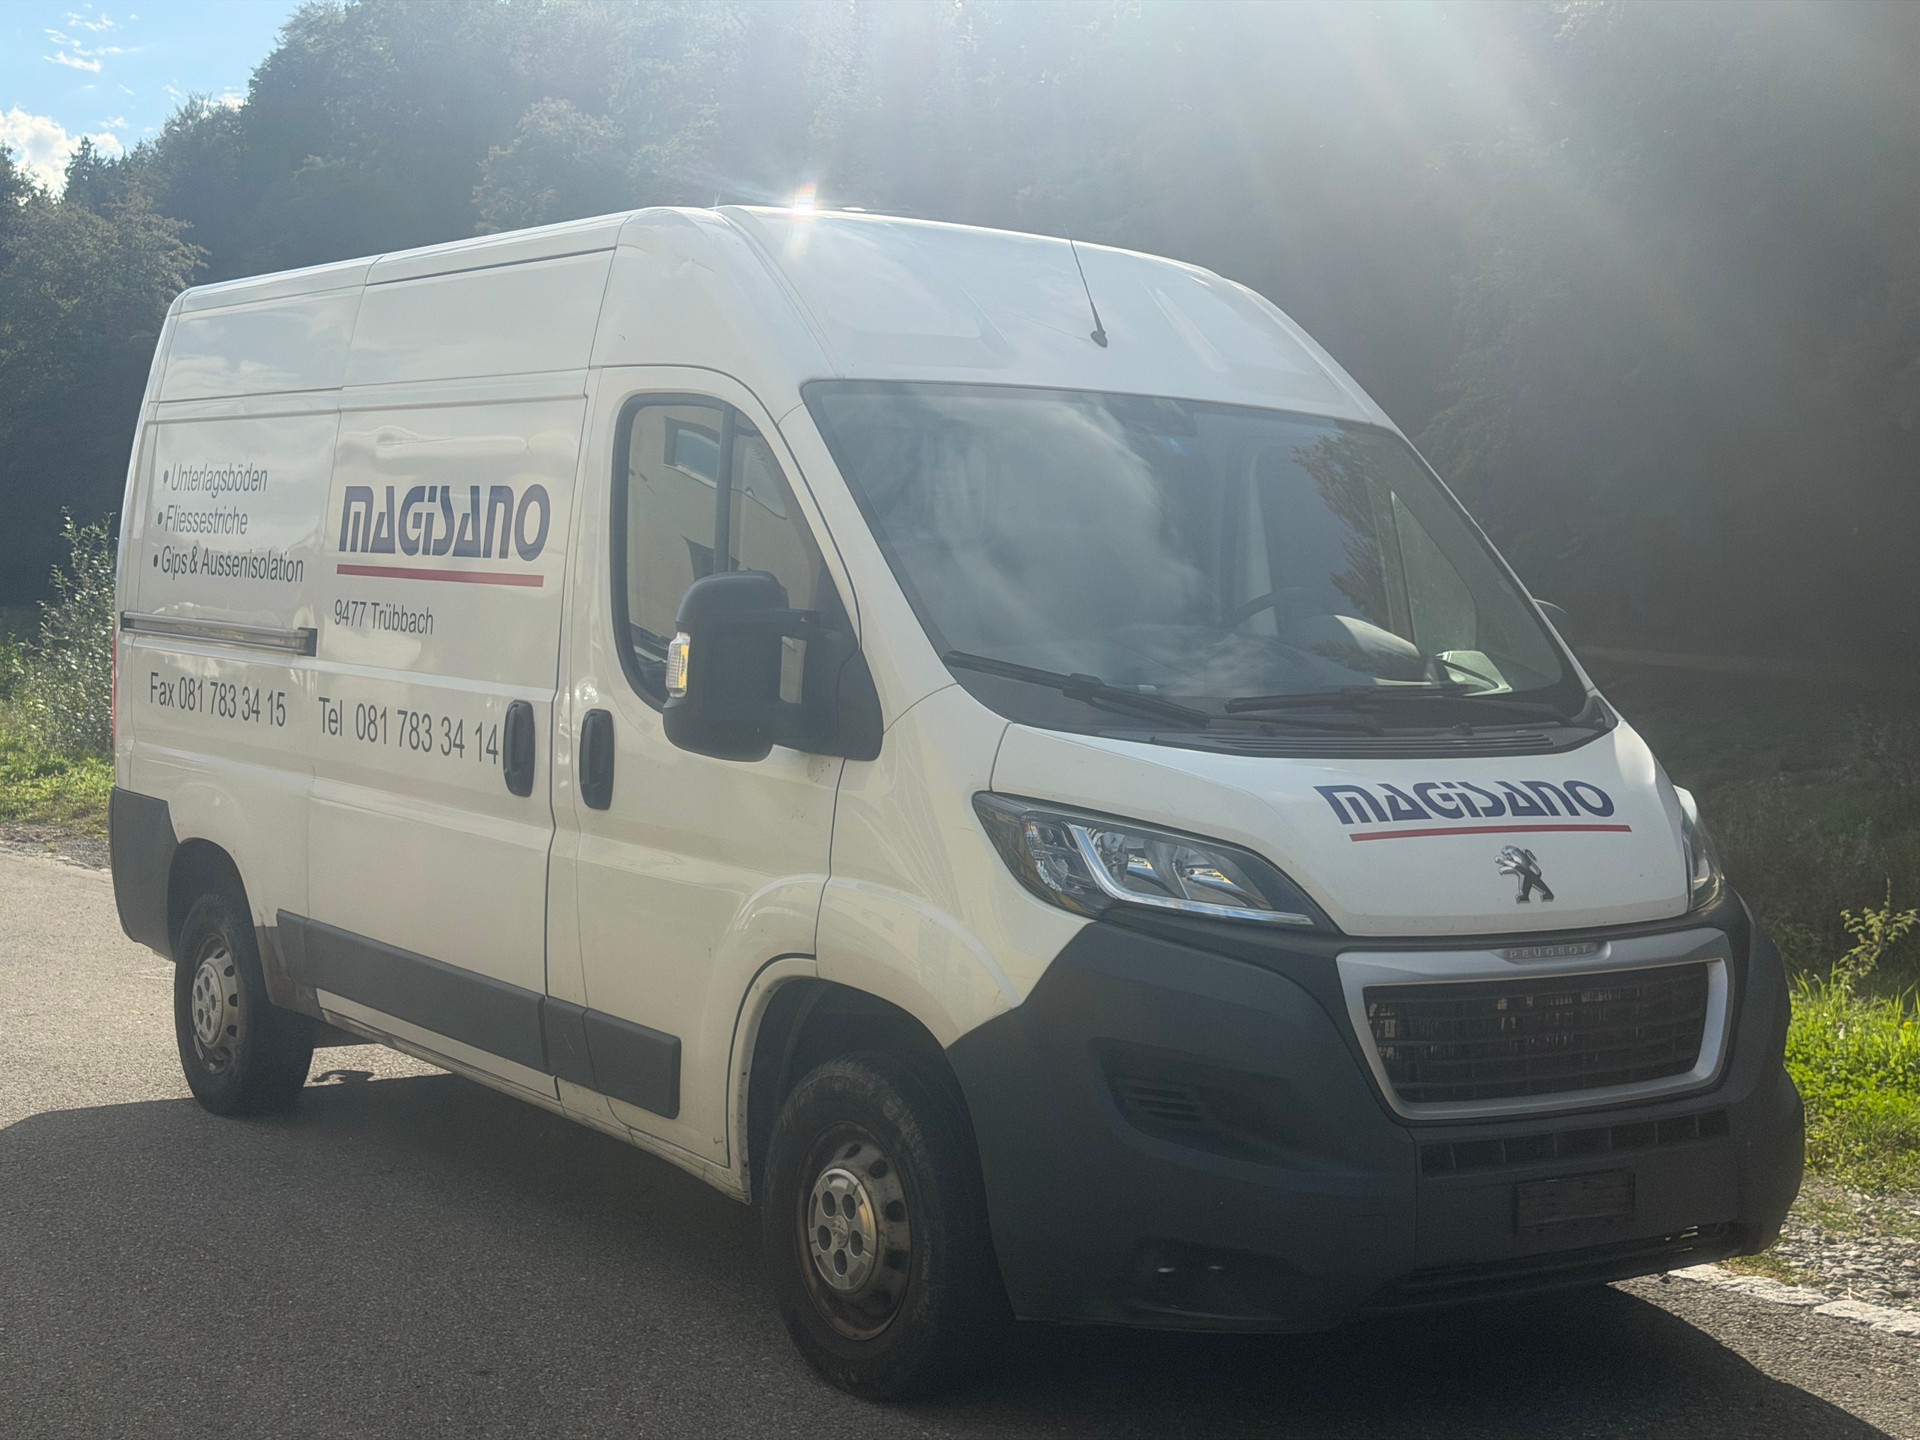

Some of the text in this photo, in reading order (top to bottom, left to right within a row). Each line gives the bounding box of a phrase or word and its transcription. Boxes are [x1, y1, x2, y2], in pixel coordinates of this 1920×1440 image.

[171, 463, 268, 497] Unterlagsböden
[165, 505, 248, 535] Fliessestriche
[161, 545, 304, 583] Gips & Aussenisolation
[334, 599, 434, 636] 9477 Trübbach
[150, 671, 286, 727] Fax 081 783 34 15
[318, 696, 499, 765] Tel 081 783 34 14
[1508, 943, 1589, 960] PEUGEOT
